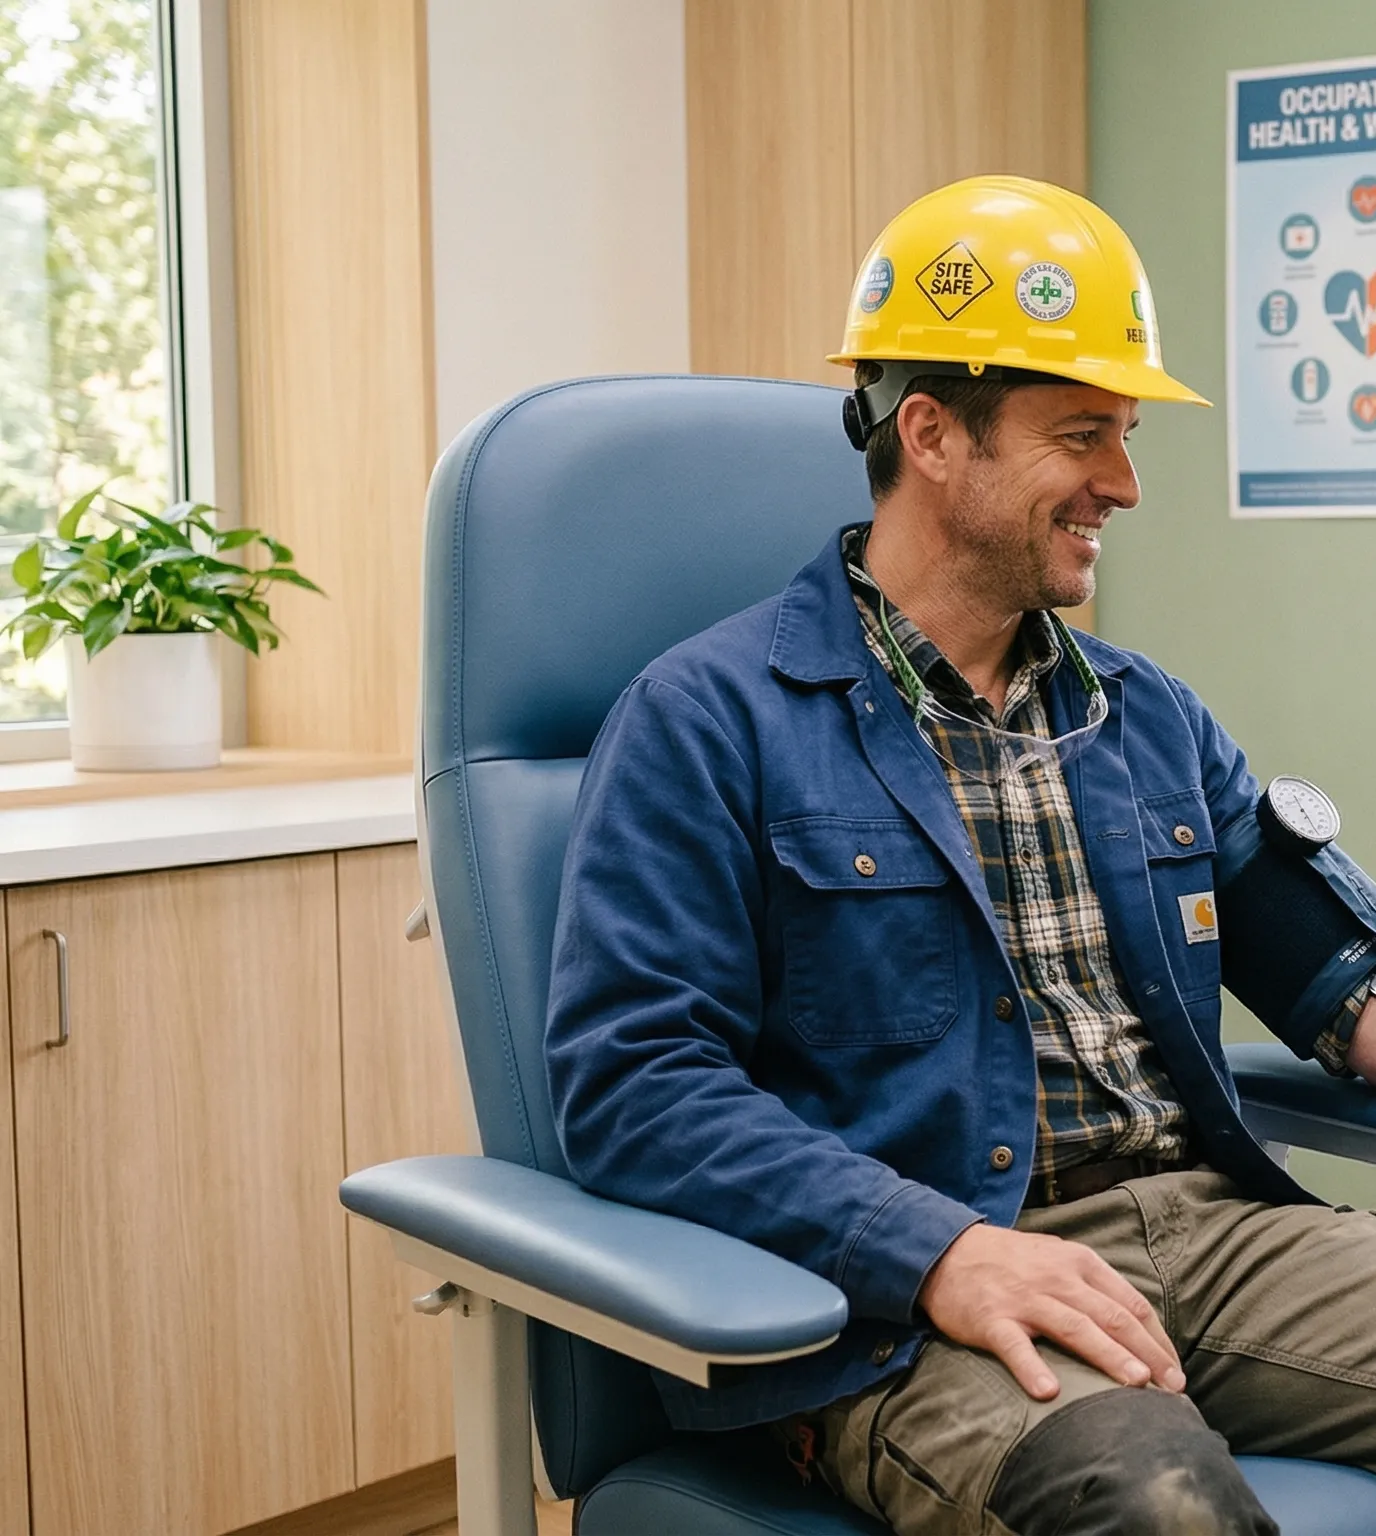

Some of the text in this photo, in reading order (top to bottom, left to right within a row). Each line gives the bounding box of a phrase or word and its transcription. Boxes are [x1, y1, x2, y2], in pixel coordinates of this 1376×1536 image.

[1249, 116, 1336, 149] HEALTH
[1340, 114, 1360, 142] &
[935, 262, 973, 279] SITE
[930, 278, 974, 296] SAFE
